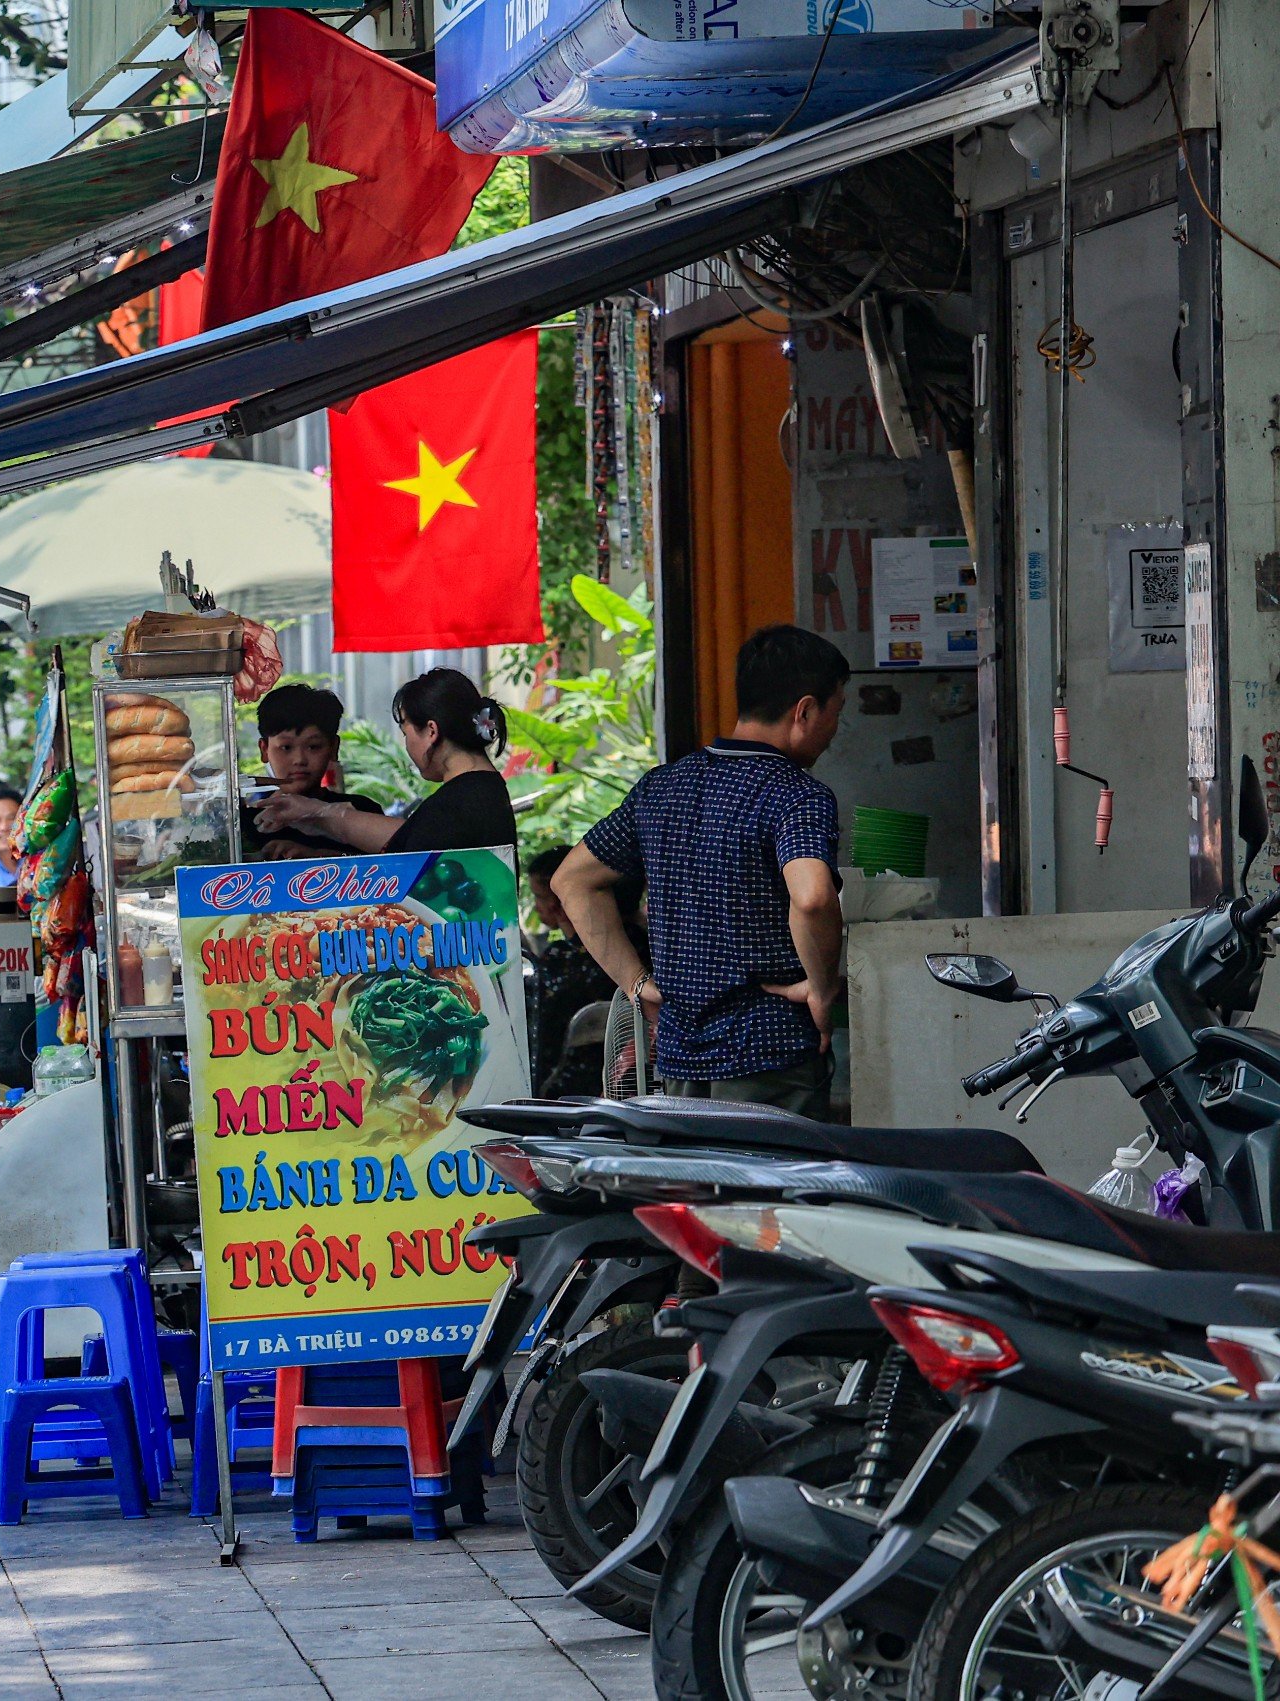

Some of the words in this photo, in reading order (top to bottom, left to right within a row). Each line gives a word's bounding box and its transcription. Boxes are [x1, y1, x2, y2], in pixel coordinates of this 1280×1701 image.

[287, 862, 400, 905] Chín
[200, 928, 267, 986] SÁNG
[318, 917, 369, 978] BÚN
[376, 923, 427, 984] DỌC
[431, 910, 509, 968] MÙNG
[208, 990, 336, 1060] BÚN
[213, 1058, 367, 1139] MIẾN
[216, 1150, 344, 1214] BÁNH
[350, 1153, 420, 1205] ĐA
[222, 1222, 378, 1299] TRỘN,
[387, 1212, 515, 1280] NƯỚ
[223, 1339, 251, 1359] 17
[258, 1332, 291, 1355] BÀ
[296, 1330, 363, 1352] TRIỆU
